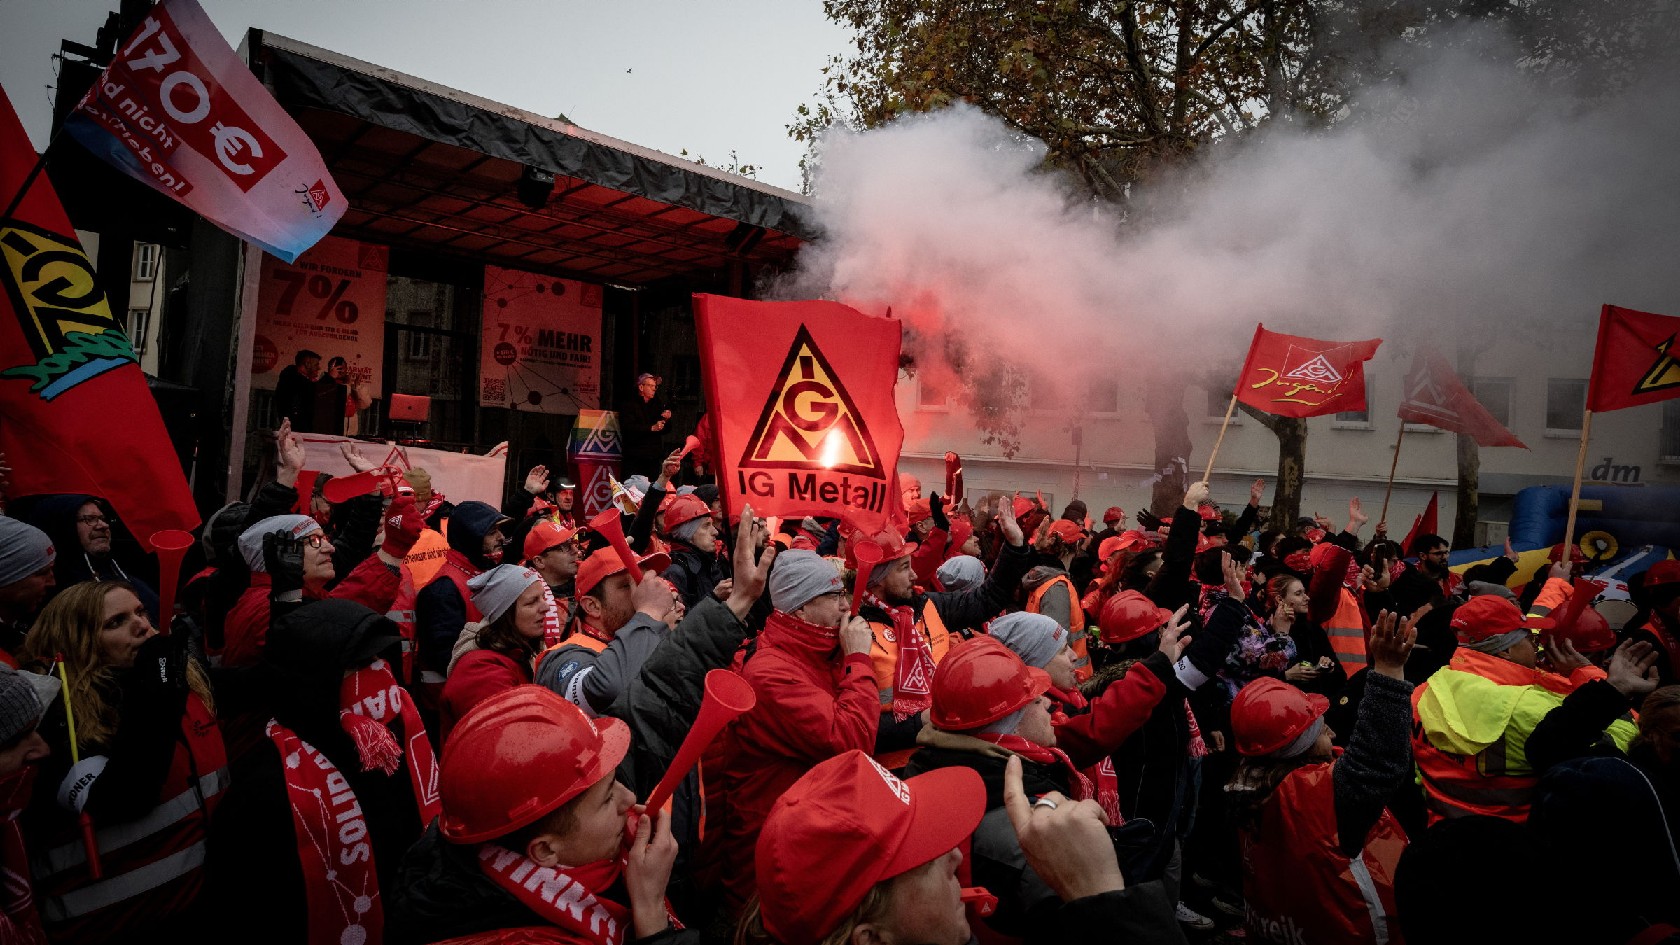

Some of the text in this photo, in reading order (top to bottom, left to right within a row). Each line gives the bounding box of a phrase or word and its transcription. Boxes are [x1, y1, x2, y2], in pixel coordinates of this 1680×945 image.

[123, 15, 211, 124] 170
[118, 97, 173, 149] nicht
[299, 261, 362, 279] WIR FORDERN
[272, 268, 360, 325] 7%
[520, 346, 548, 358] NÖTIG
[549, 349, 568, 361] UND
[538, 328, 592, 353] MEHR
[1591, 458, 1641, 482] dm
[738, 470, 887, 514] IG Metall
